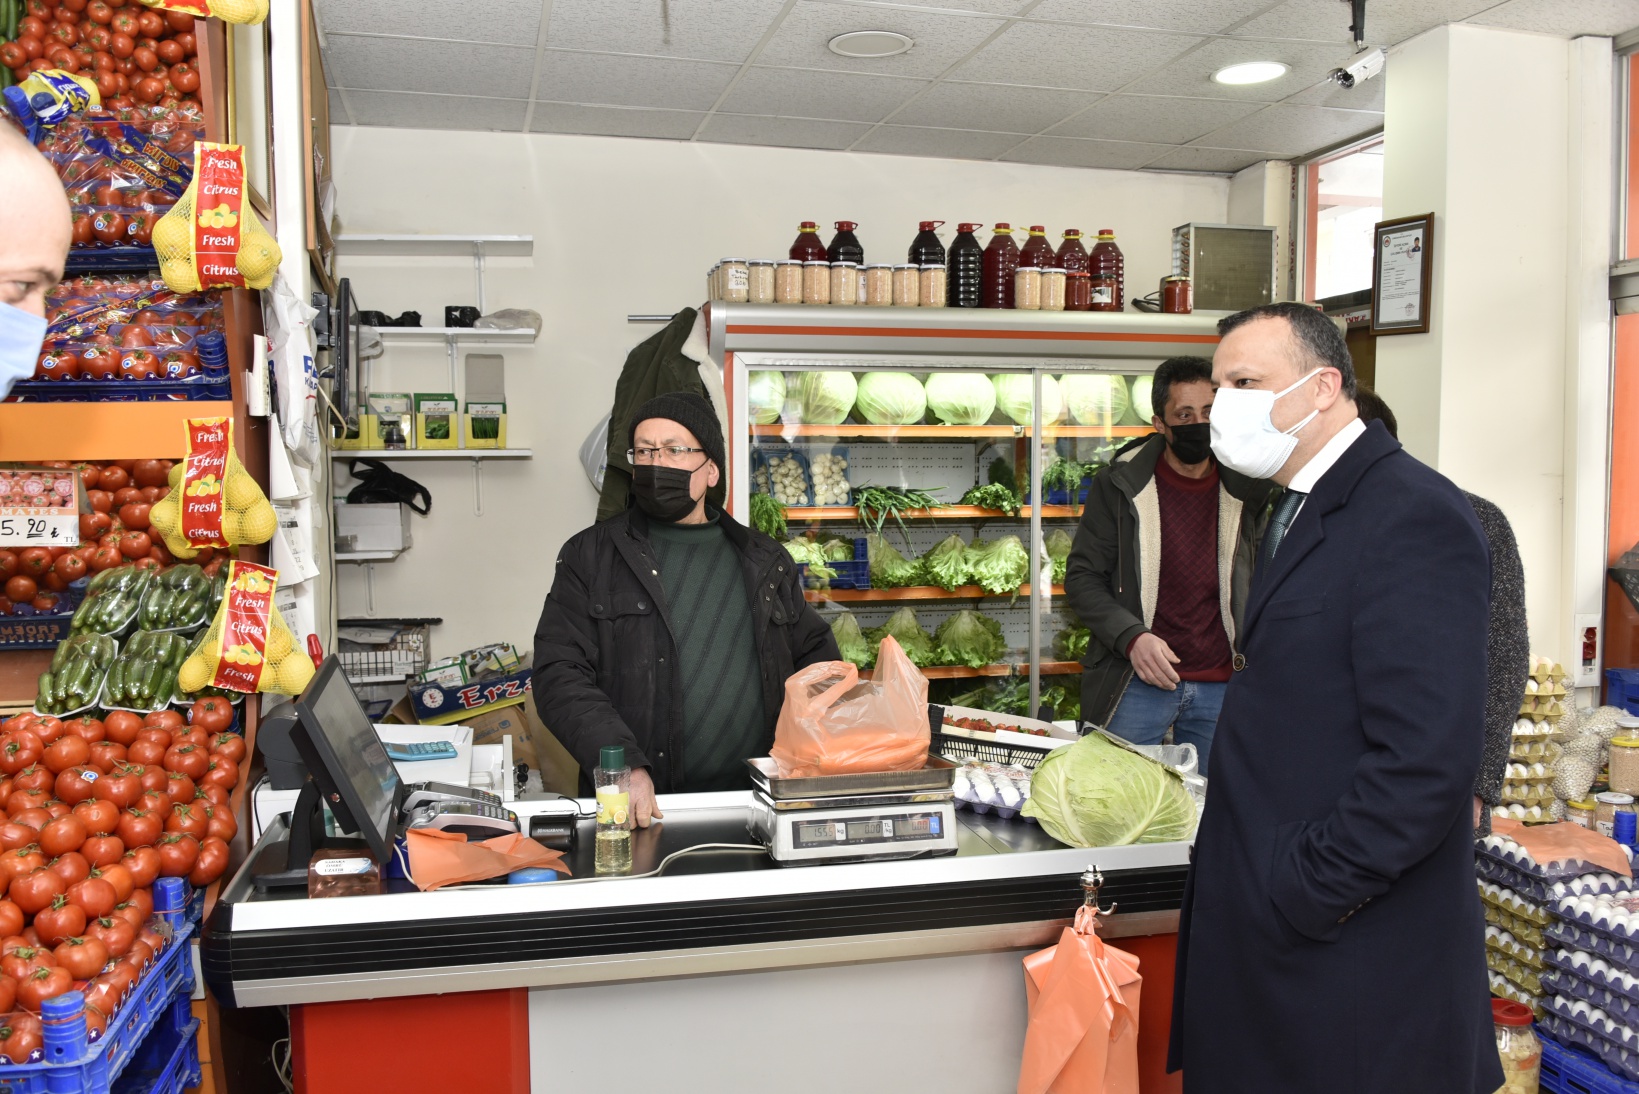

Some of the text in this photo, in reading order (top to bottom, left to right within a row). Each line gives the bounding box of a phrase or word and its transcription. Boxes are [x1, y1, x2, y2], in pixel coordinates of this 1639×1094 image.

[208, 157, 237, 170] Fresh
[203, 184, 239, 195] Citrus
[202, 234, 235, 246] Fresh
[202, 264, 239, 276] Citrus
[197, 432, 224, 443] Fresh
[188, 502, 217, 513] Fresh
[188, 528, 220, 539] Citrus
[235, 597, 265, 609] Fresh
[231, 621, 264, 635] Citrus
[223, 667, 256, 682] Fresh
